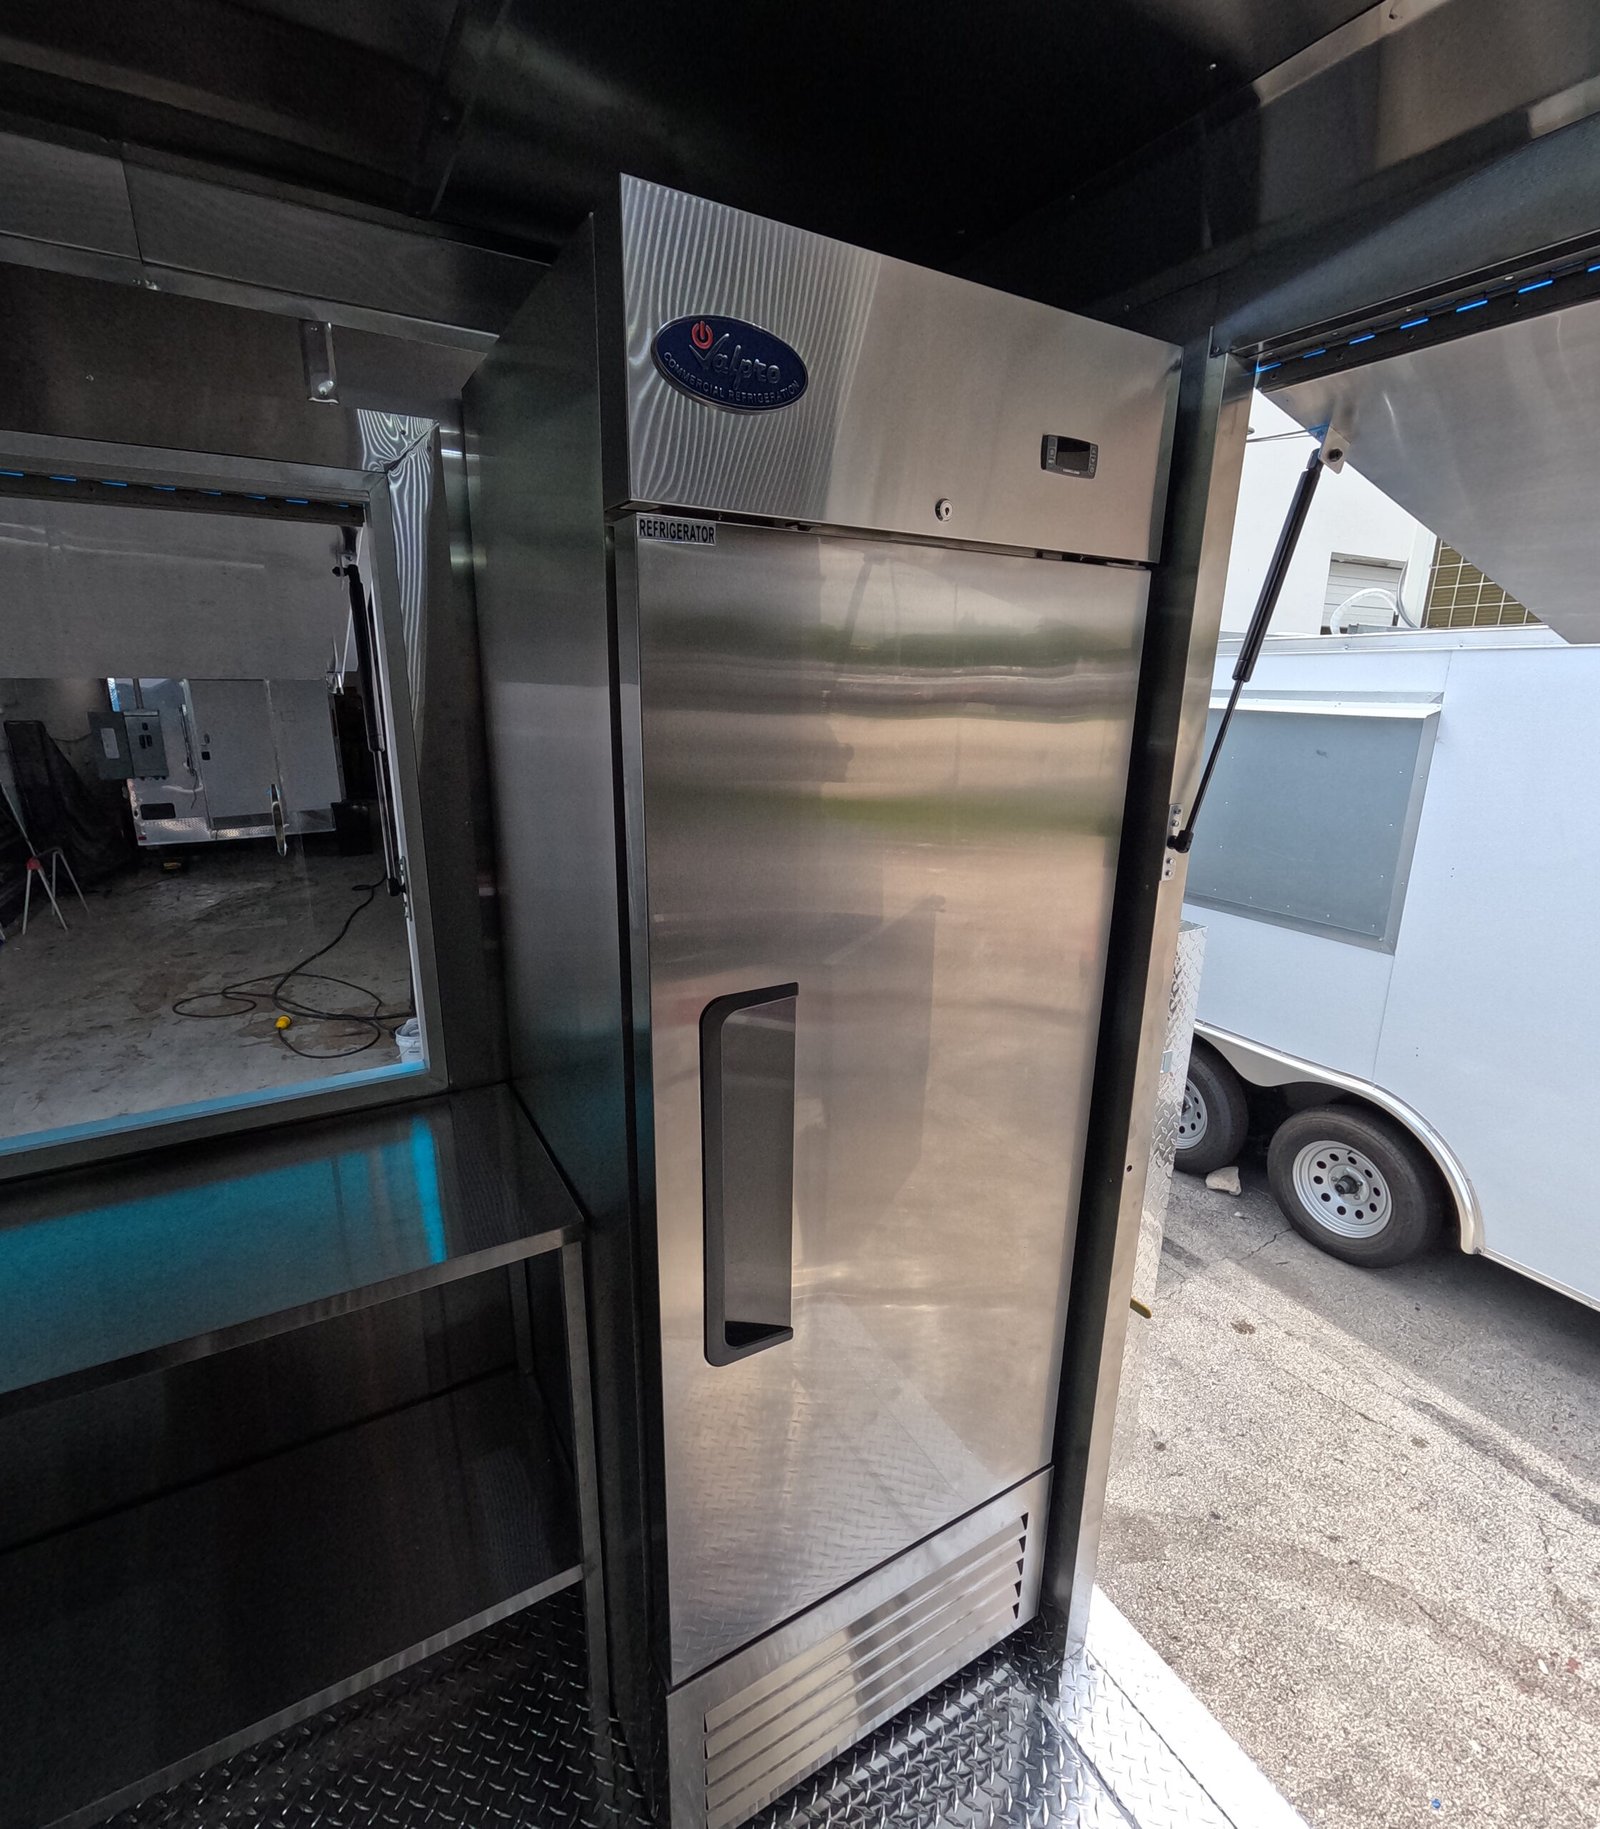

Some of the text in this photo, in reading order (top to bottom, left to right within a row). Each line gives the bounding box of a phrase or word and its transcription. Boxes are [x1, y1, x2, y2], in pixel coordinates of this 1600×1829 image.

[663, 351, 800, 404] COMMERCIAL REFRIGERATION
[639, 519, 715, 544] REFRIGERATOR
